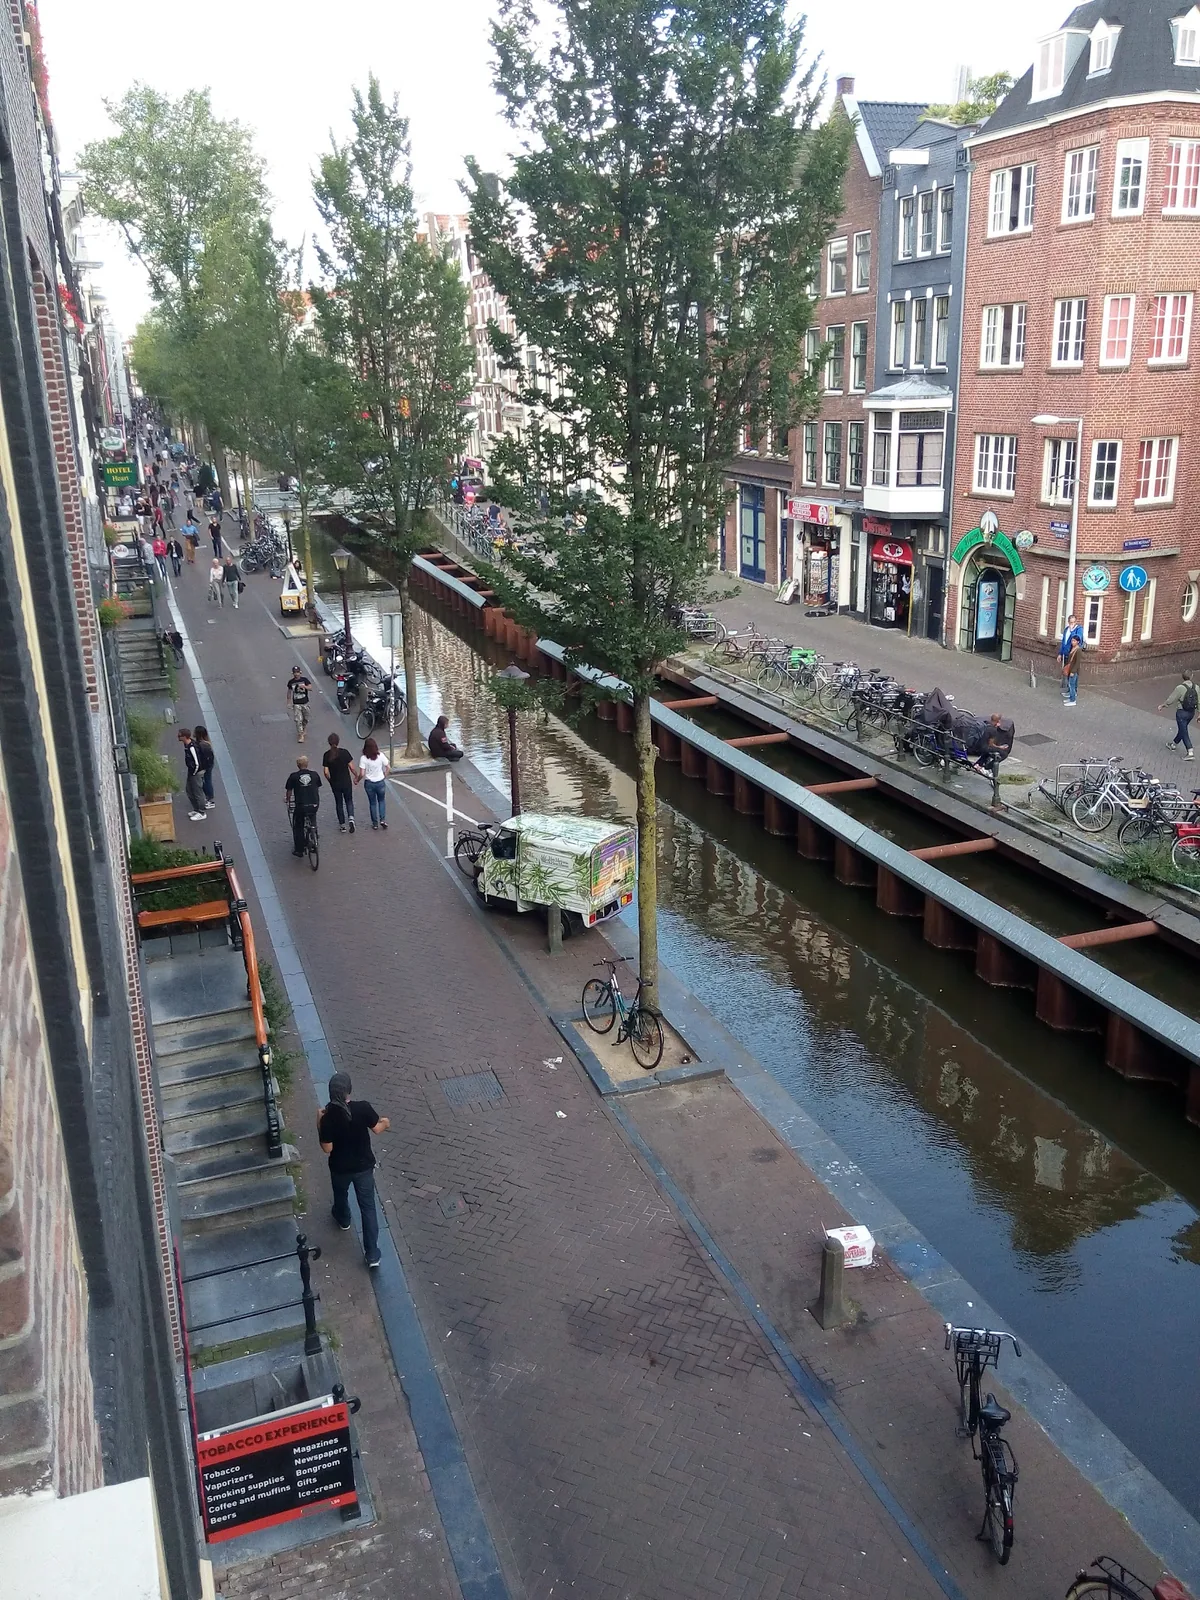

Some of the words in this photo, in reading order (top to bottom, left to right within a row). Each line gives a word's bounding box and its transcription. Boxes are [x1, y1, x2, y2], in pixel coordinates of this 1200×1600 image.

[199, 1434, 263, 1460] TOBACCO
[265, 1411, 345, 1442] EXPERIENCE
[293, 1437, 339, 1455] Magazines
[294, 1446, 348, 1466] Newspapers
[203, 1464, 241, 1481] Tobacco
[295, 1459, 341, 1477] Bongroom
[205, 1473, 254, 1492] Vaporizers
[206, 1484, 246, 1503] Smoking
[247, 1475, 285, 1492] supplies
[296, 1476, 318, 1488] Gifts
[298, 1481, 342, 1499] Ice-cream
[208, 1500, 238, 1514] Coffee
[239, 1494, 256, 1505] and
[257, 1484, 291, 1500] muffins
[210, 1512, 237, 1525] Beers
